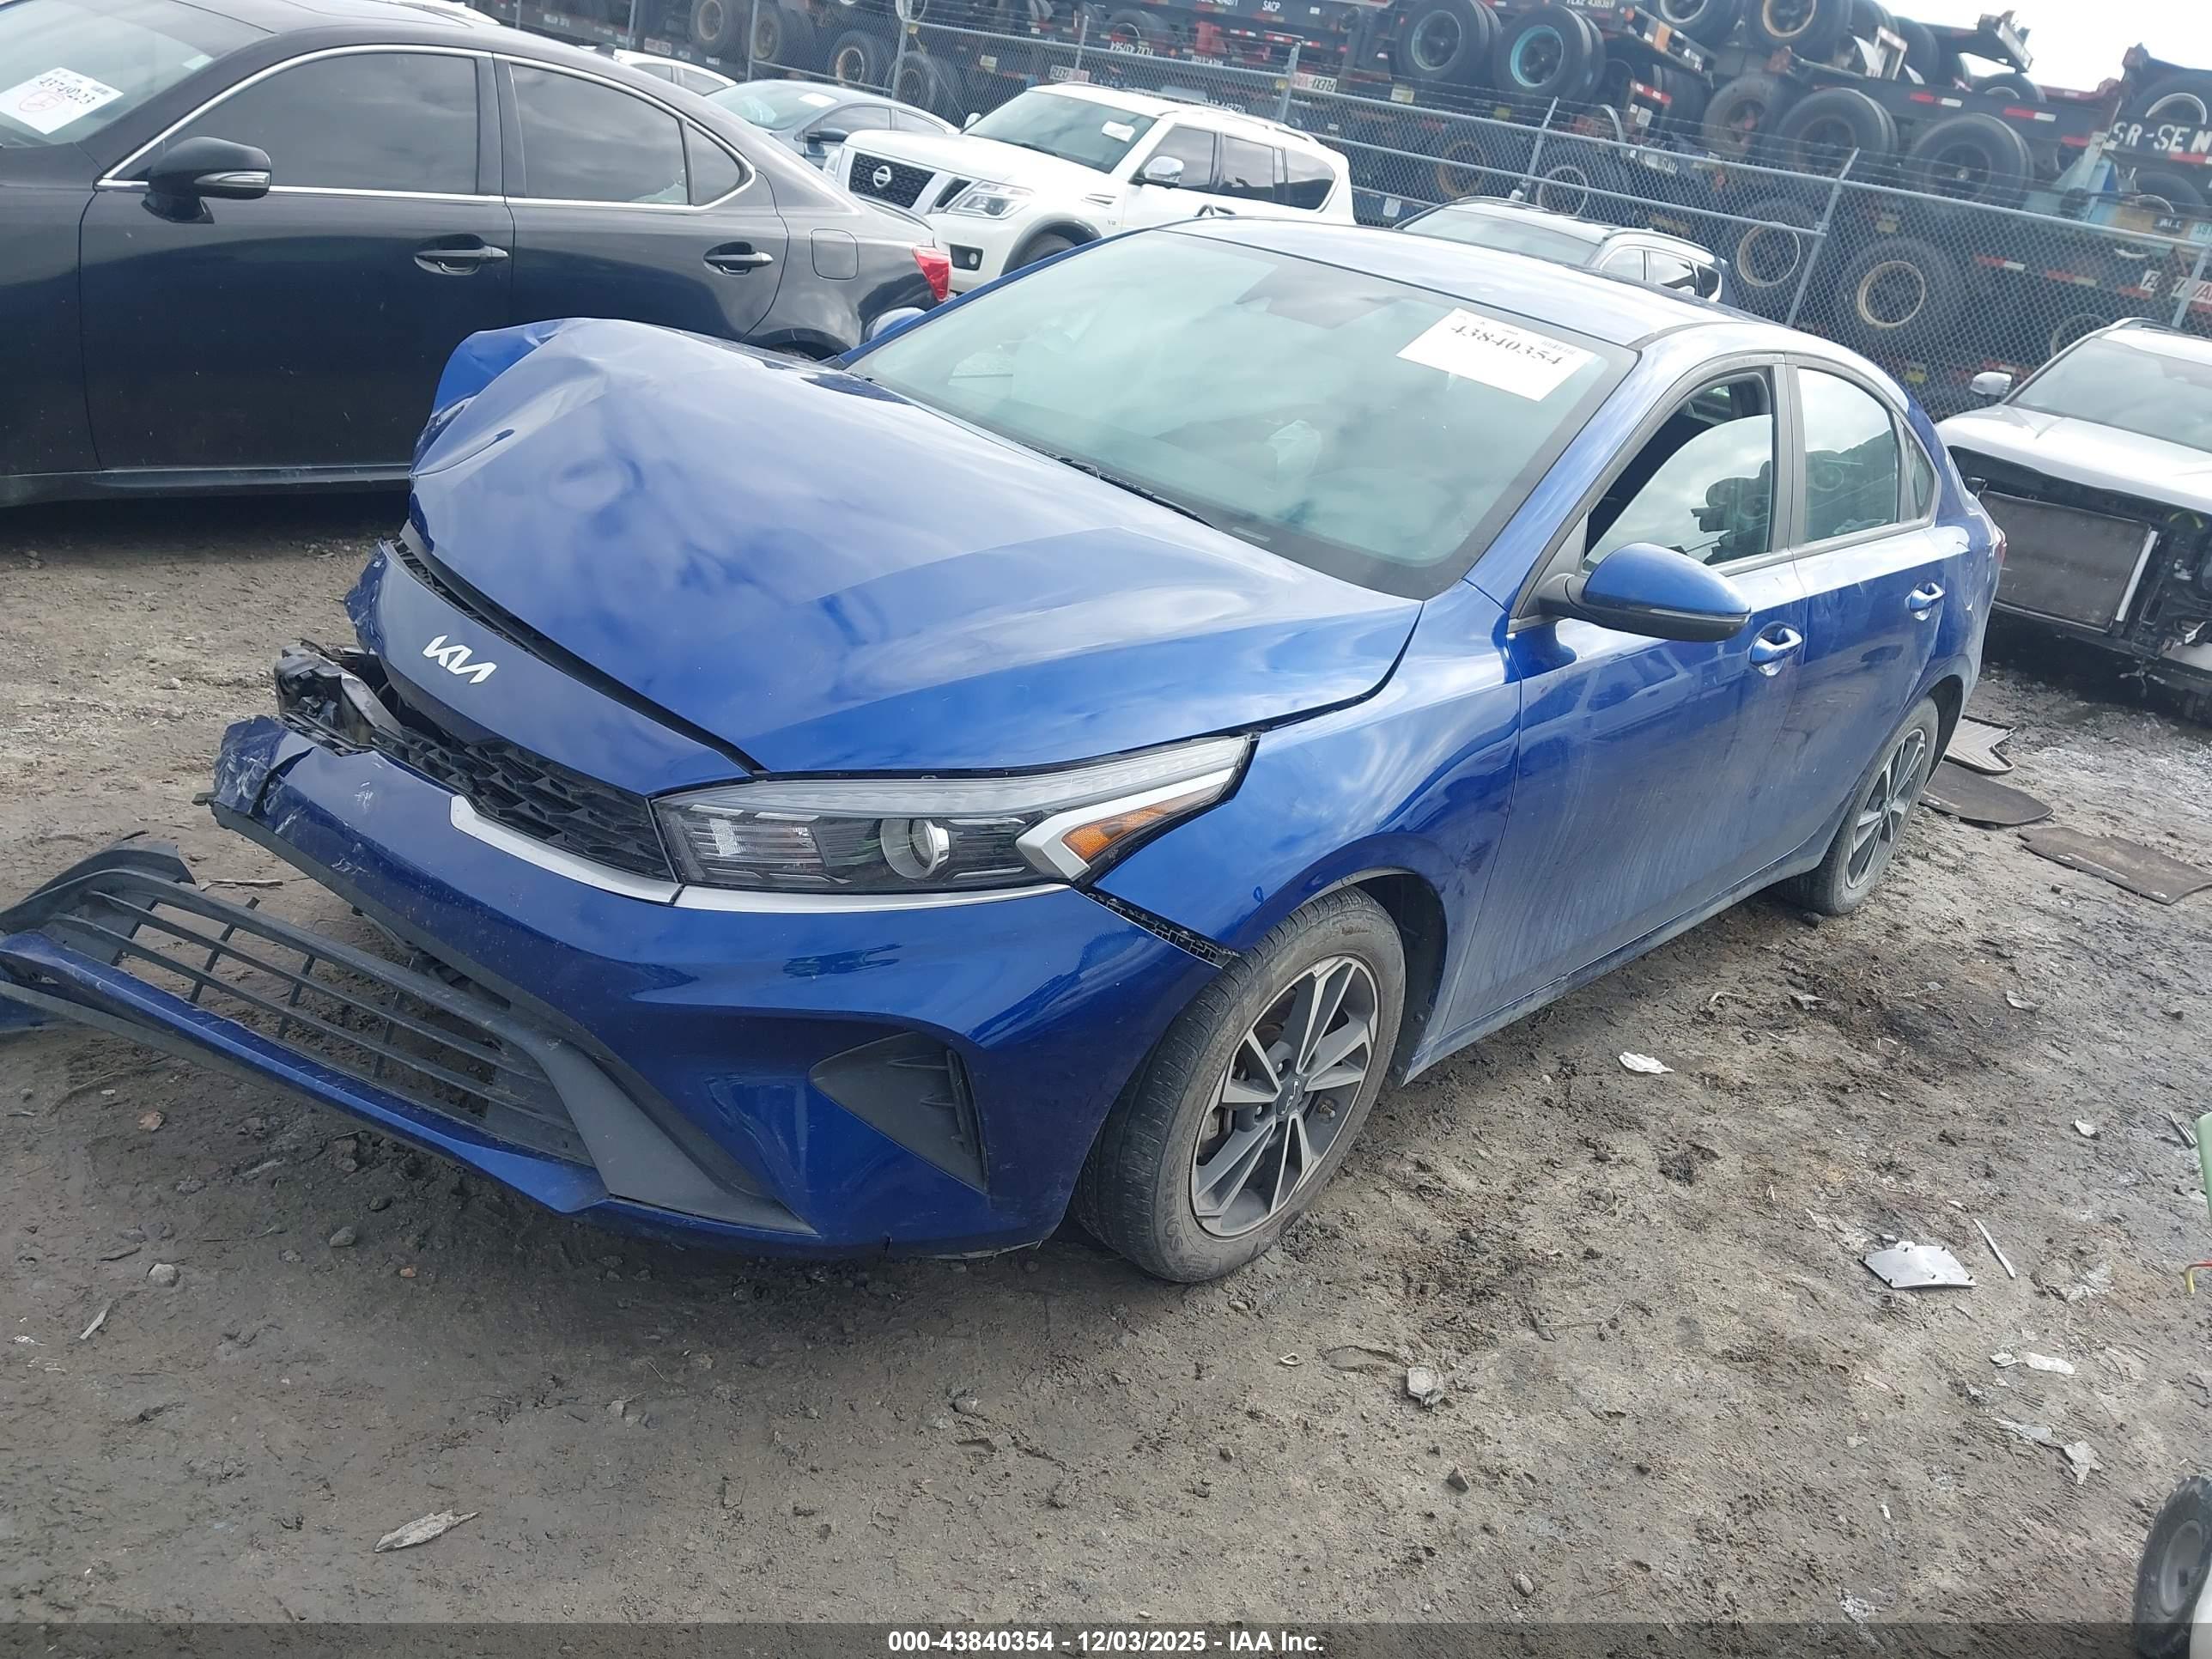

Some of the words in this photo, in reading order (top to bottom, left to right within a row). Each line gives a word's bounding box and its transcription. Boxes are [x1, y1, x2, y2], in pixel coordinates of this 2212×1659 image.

[1261, 0, 1282, 13] SACP
[1449, 324, 1565, 366] 43840354
[422, 634, 498, 684] KIA
